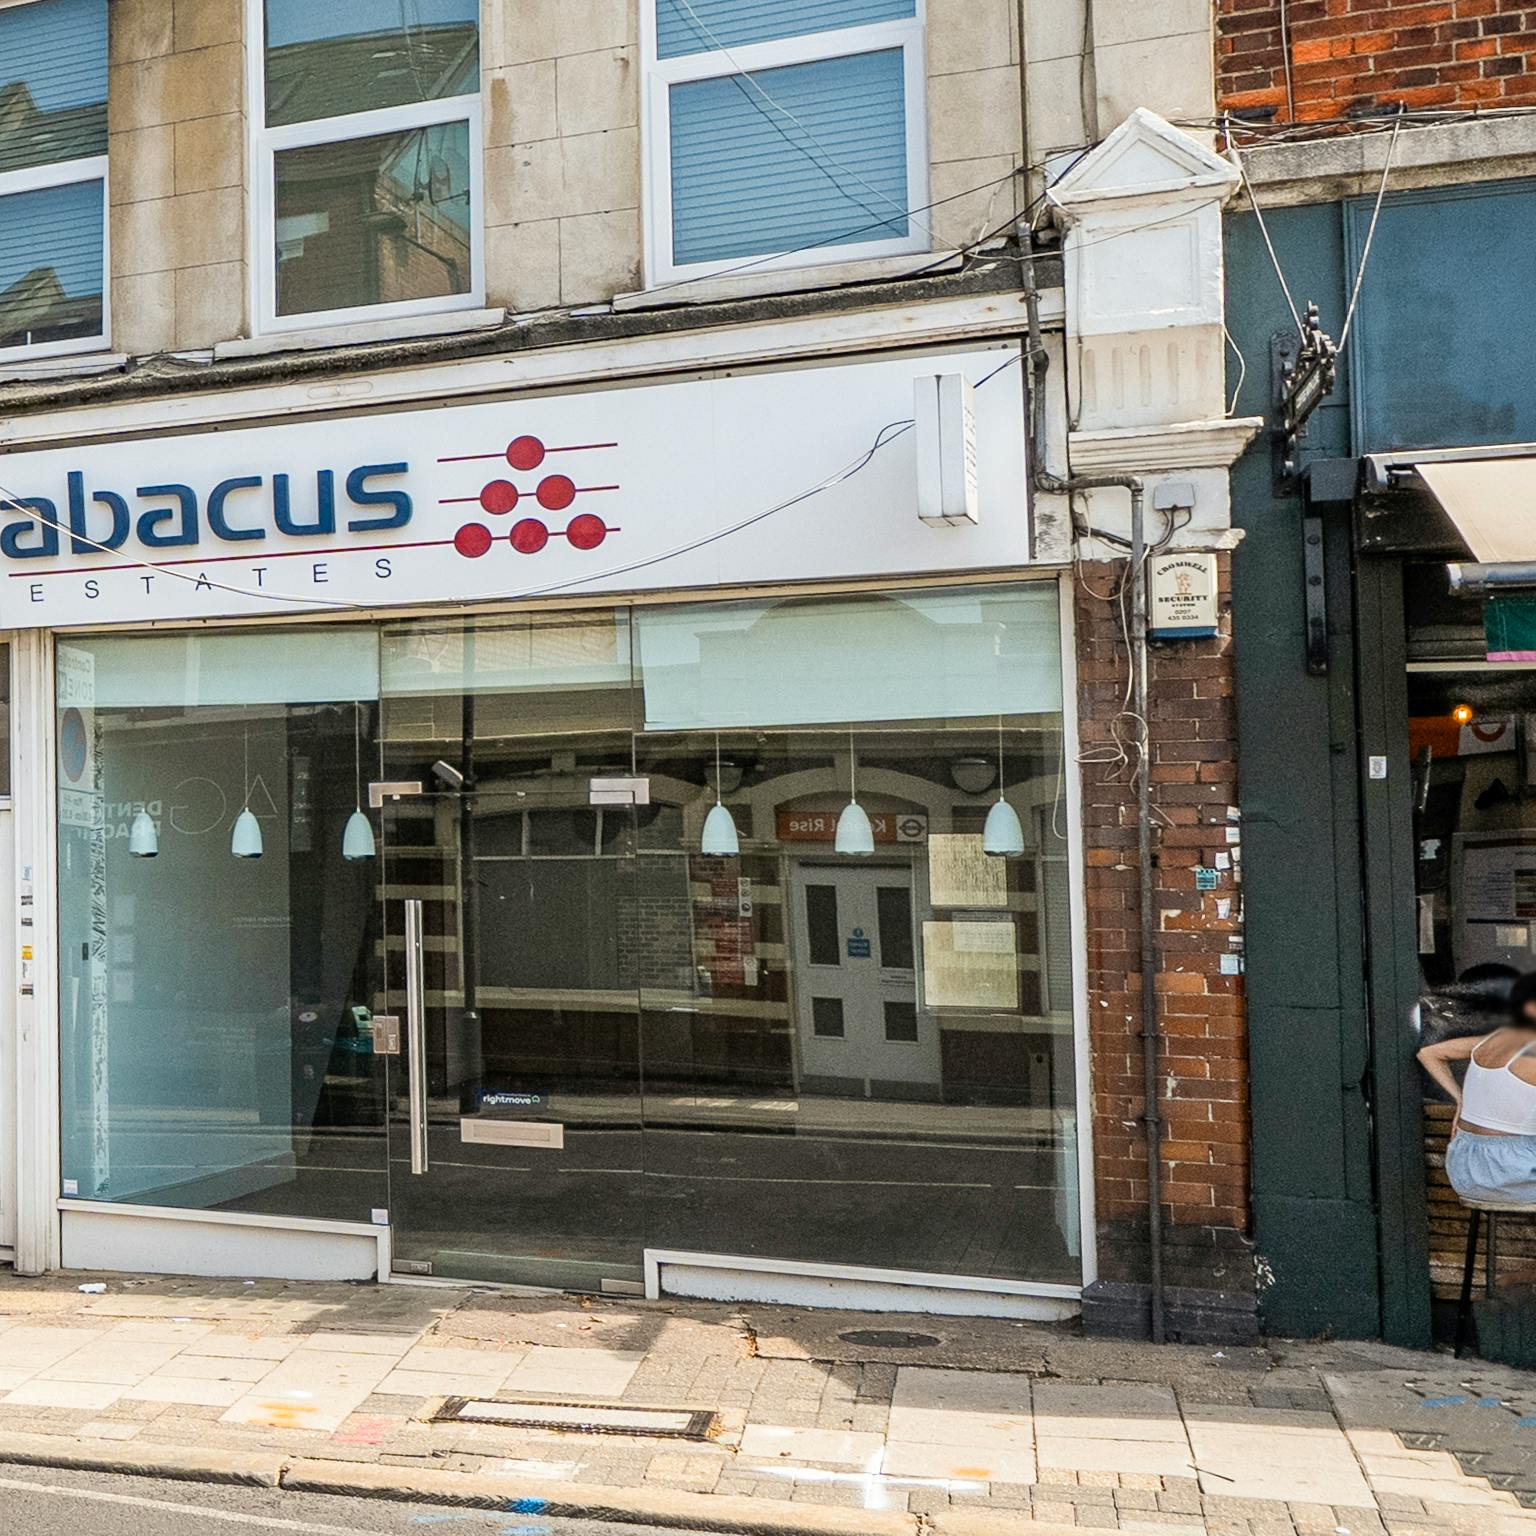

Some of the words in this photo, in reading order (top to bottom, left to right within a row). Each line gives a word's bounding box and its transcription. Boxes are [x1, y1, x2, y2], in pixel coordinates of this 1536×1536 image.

[1157, 562, 1208, 576] CROMWELL
[29, 557, 392, 604] ESTATES
[1158, 595, 1208, 603] SECURITY
[483, 1094, 532, 1104] rightmove
